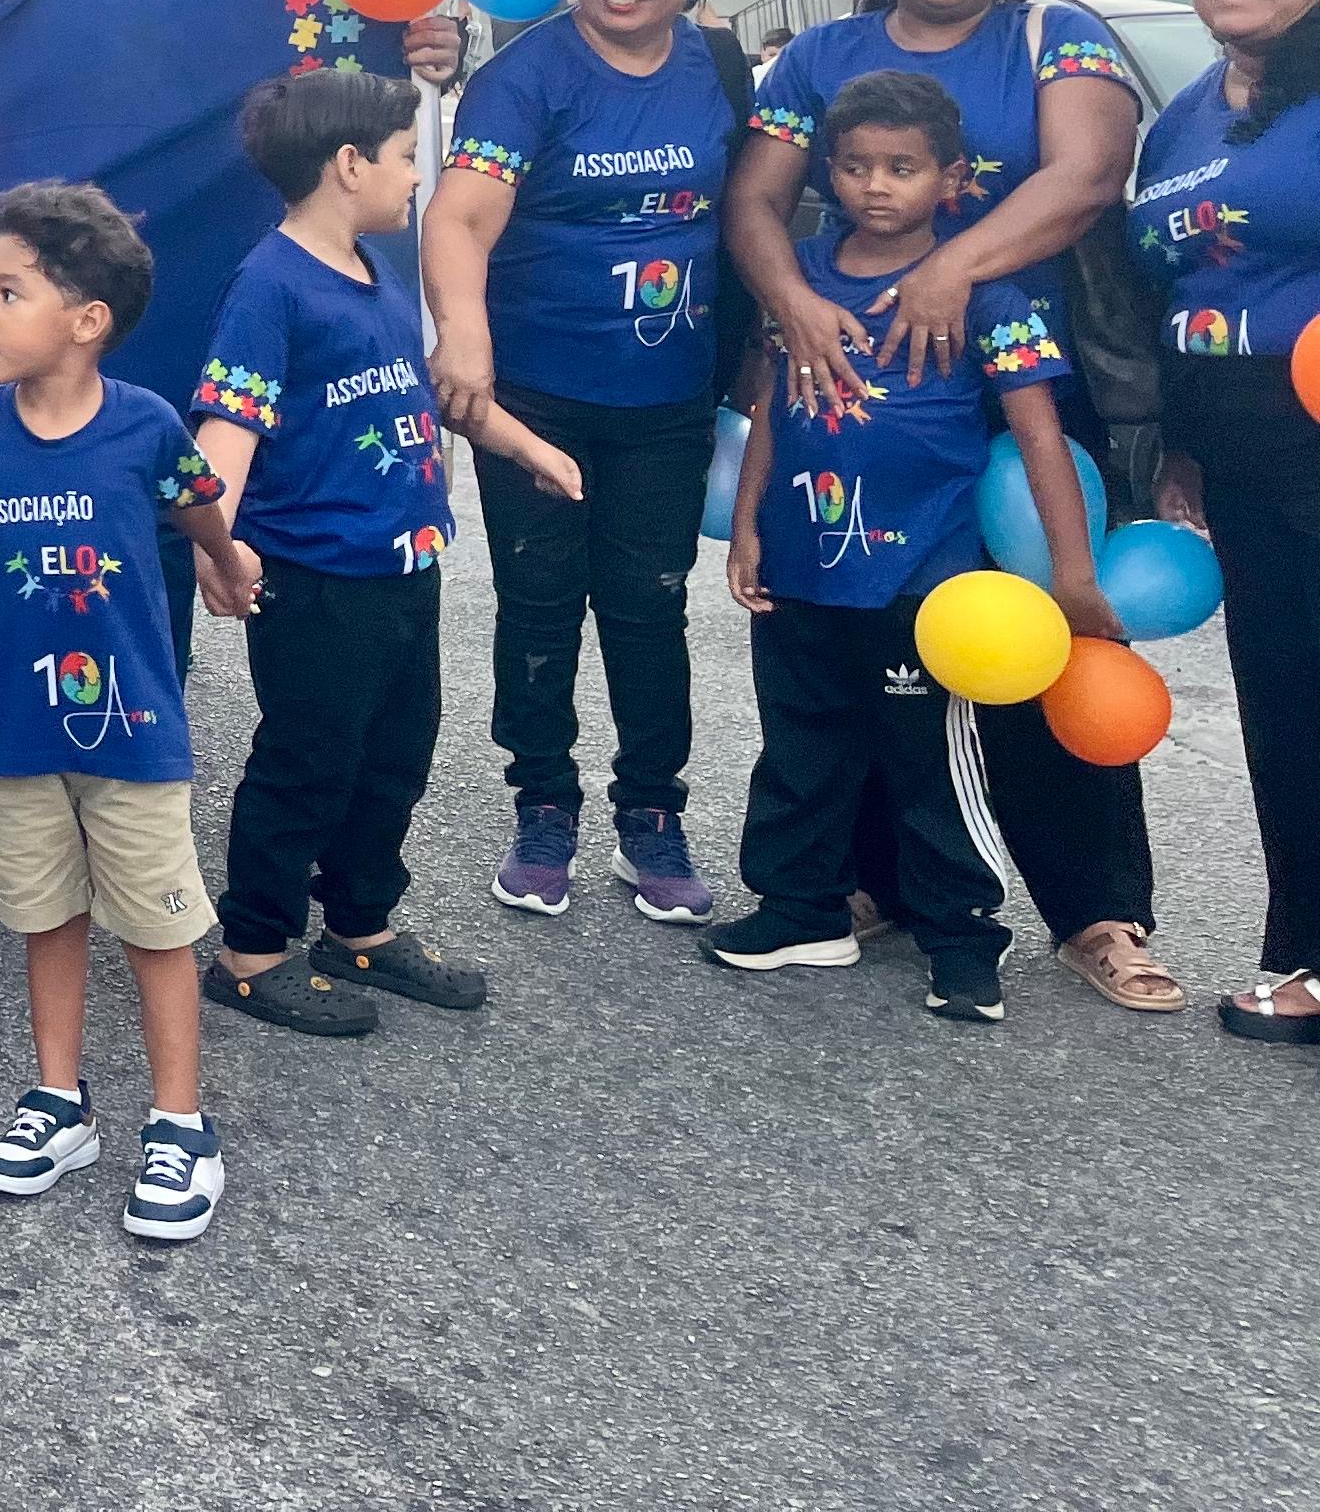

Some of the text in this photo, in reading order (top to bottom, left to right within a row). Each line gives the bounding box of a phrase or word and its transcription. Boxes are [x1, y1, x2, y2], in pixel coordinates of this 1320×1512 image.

[572, 143, 695, 178] ASSOCIAÇÃO
[640, 191, 696, 215] ELO
[1168, 200, 1217, 242] ELO
[611, 258, 680, 311] 10
[792, 470, 846, 525] 10
[41, 544, 99, 576] ELO
[32, 651, 102, 707] 10
[884, 685, 929, 695] adidas
